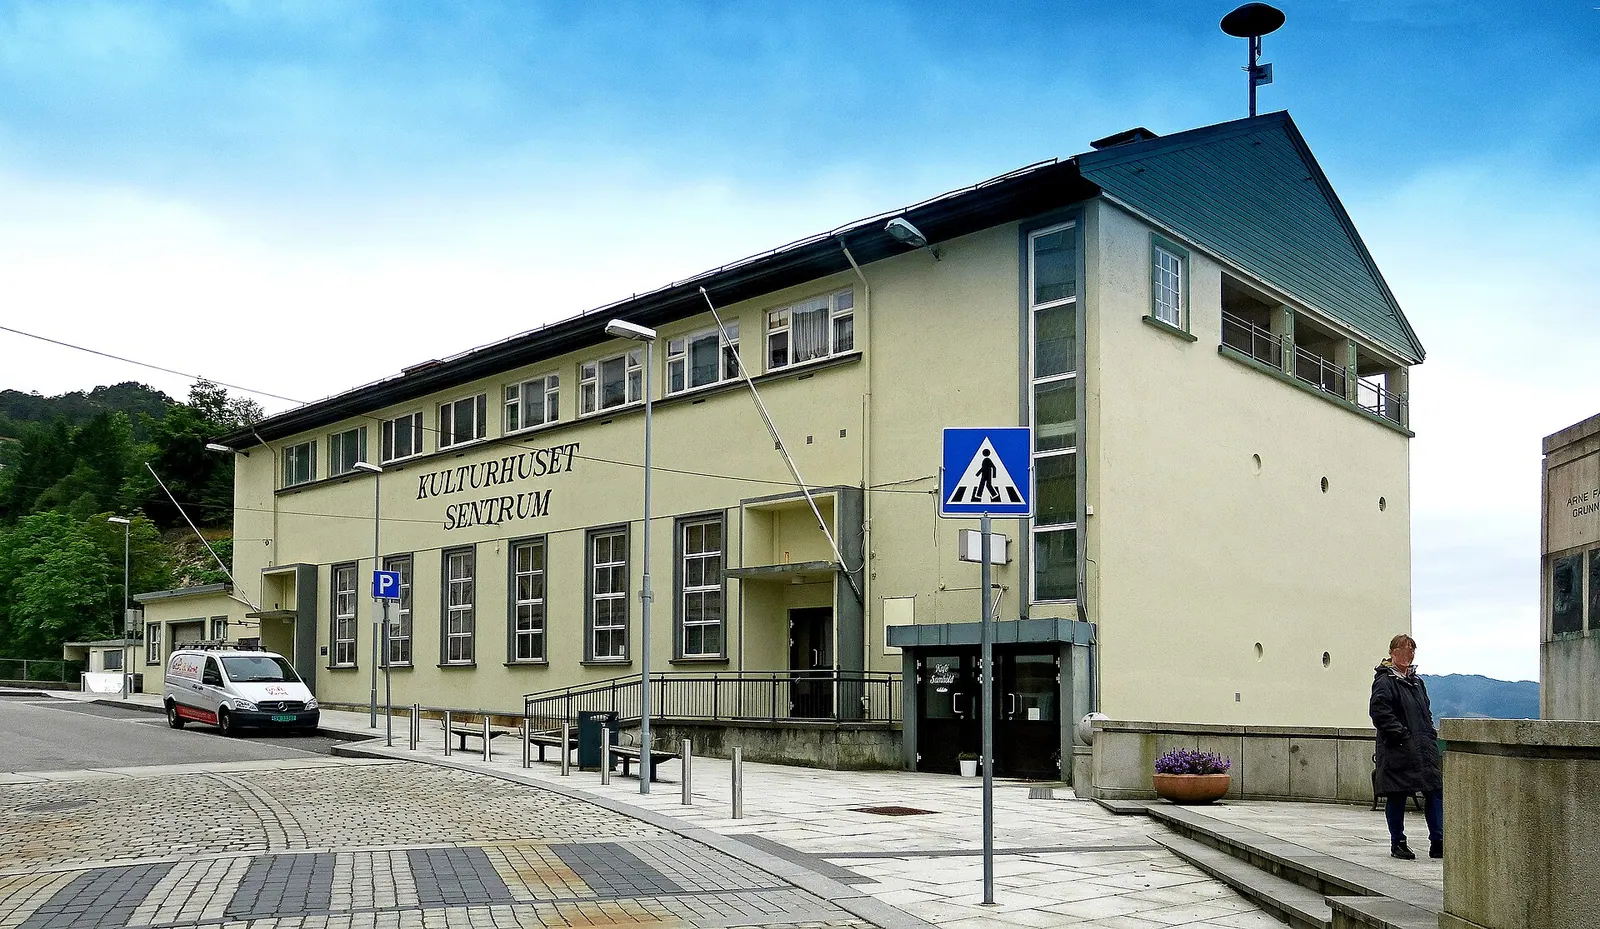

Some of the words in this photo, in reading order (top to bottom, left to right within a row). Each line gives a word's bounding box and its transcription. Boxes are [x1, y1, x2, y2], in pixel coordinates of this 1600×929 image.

[416, 442, 580, 500] KULTURHUSET
[1566, 492, 1589, 507] ARNE
[443, 489, 553, 531] SENTRUM
[1572, 502, 1600, 518] GRUNN
[379, 574, 394, 594] P
